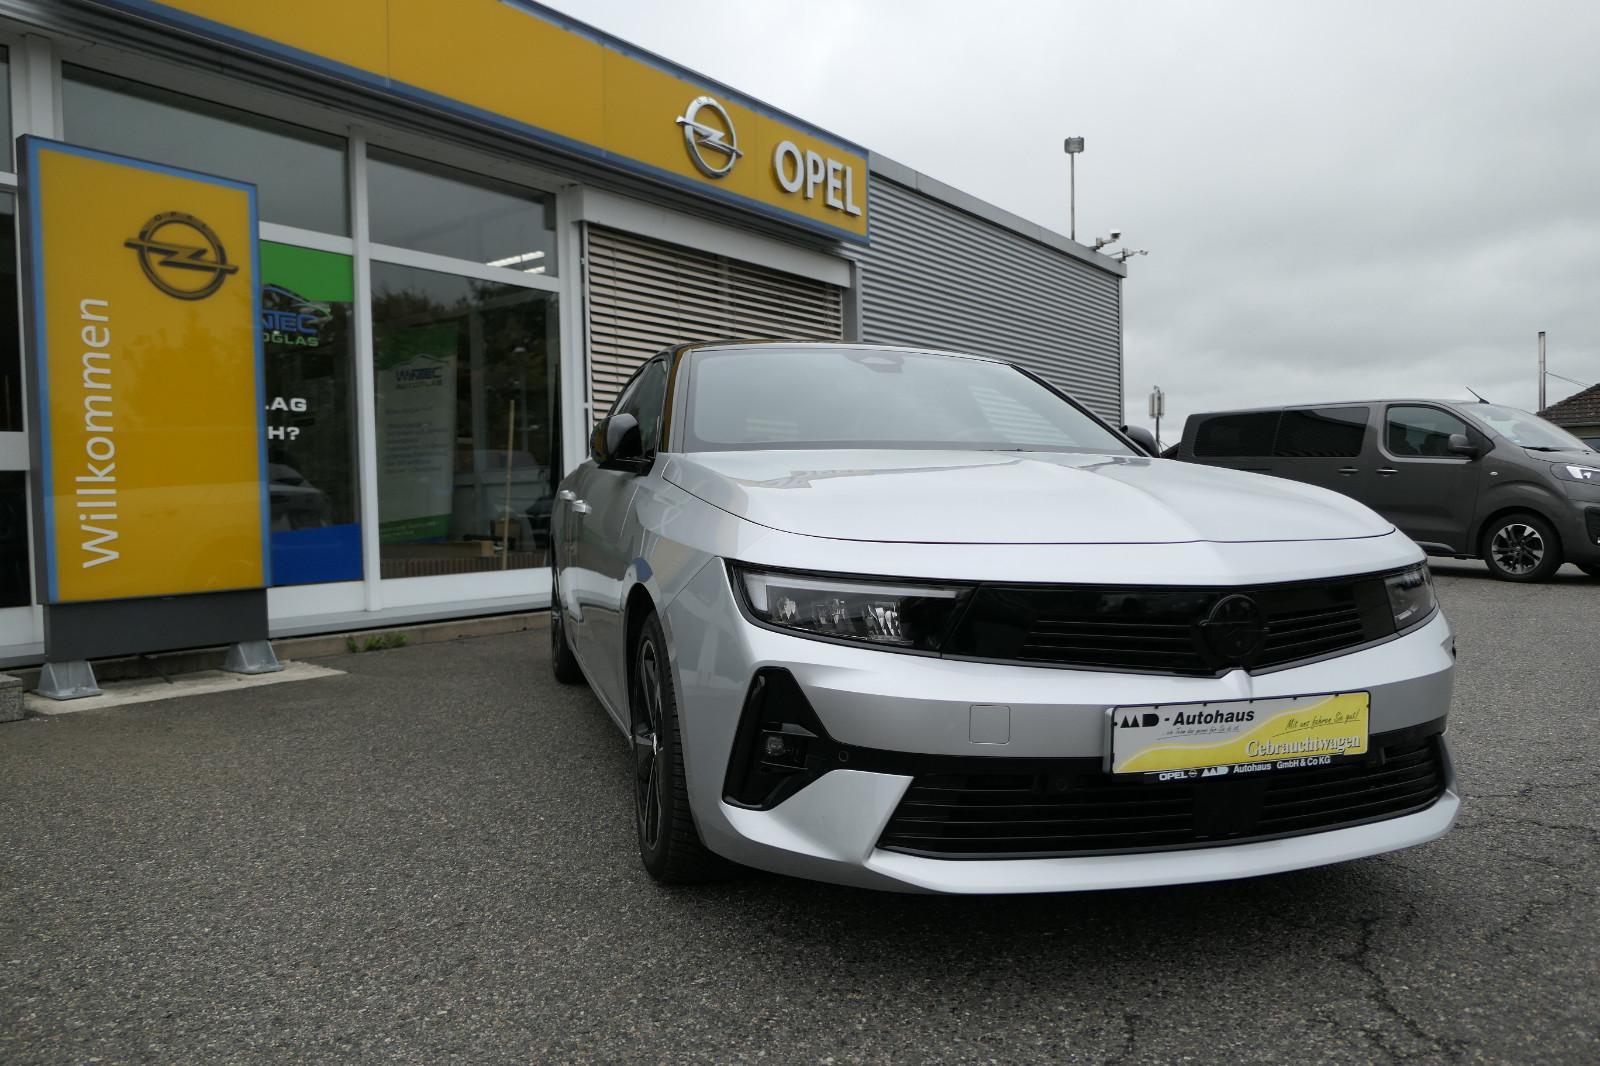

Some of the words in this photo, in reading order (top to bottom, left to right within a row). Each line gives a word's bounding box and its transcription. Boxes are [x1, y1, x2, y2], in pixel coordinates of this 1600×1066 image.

[775, 140, 862, 216] OPEL
[265, 397, 307, 411] AG
[76, 296, 119, 569] Willkommen
[1173, 710, 1255, 726] Autohaus
[1246, 735, 1360, 757] Gebrauchtwagen
[1159, 771, 1188, 781] OPEL
[1233, 763, 1272, 774] Autohaus
[1276, 760, 1299, 769] GmbH
[1299, 758, 1307, 767] &
[1307, 758, 1318, 766] Co
[1318, 755, 1331, 765] KG
